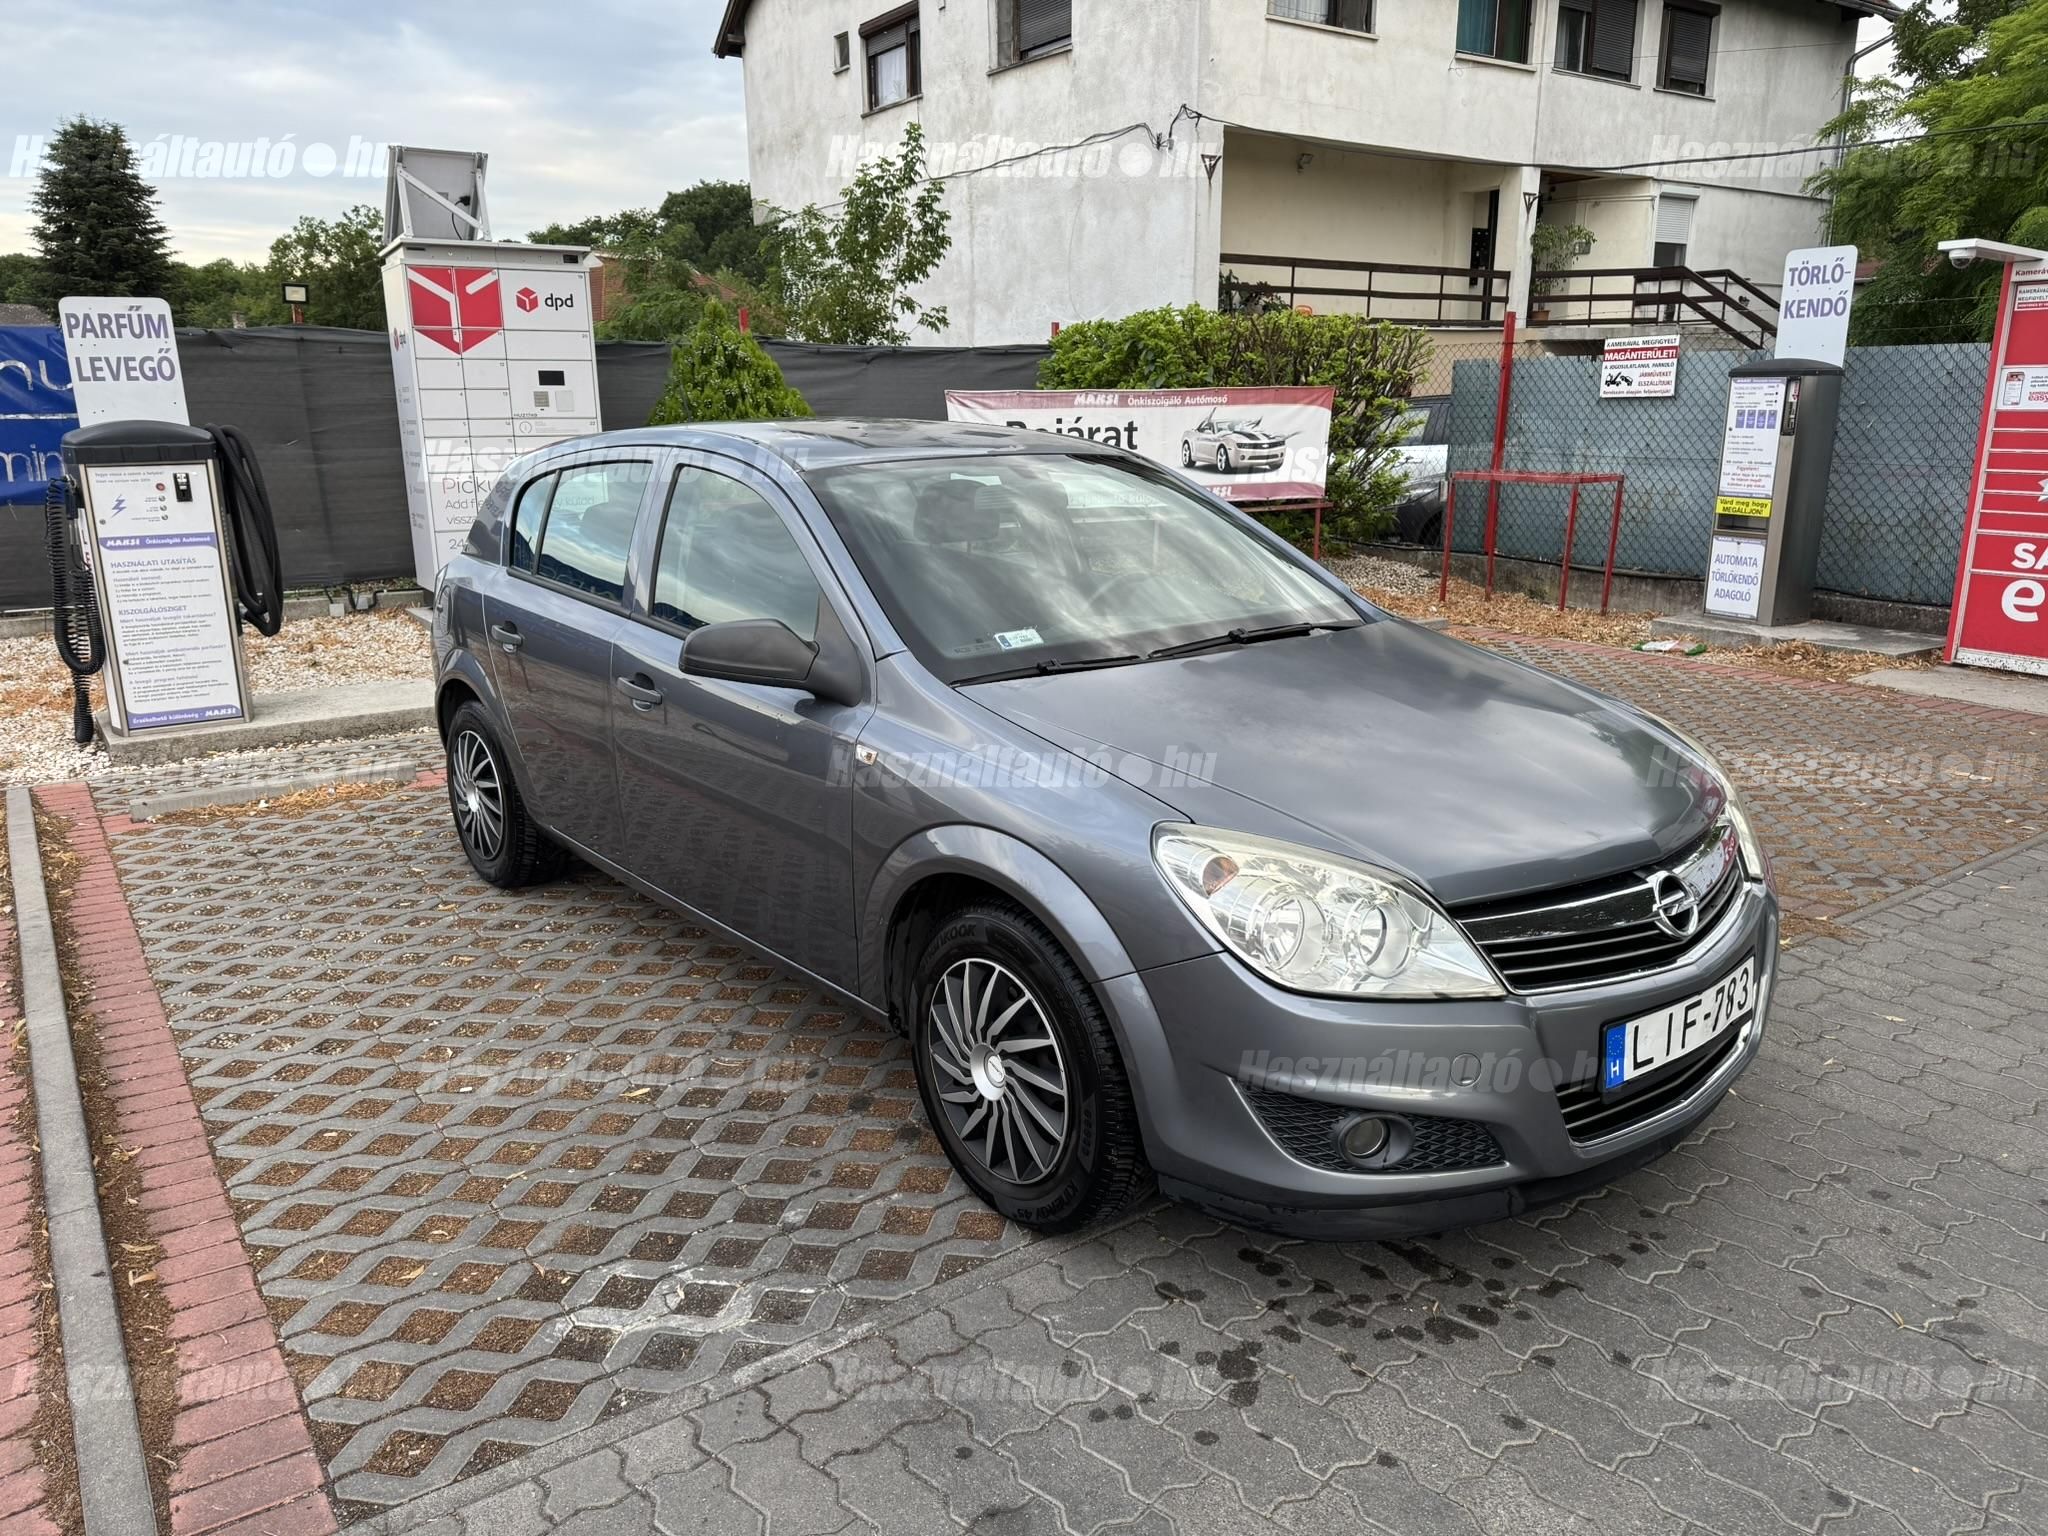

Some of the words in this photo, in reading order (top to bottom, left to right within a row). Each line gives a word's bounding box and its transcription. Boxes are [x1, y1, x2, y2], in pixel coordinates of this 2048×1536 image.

[1789, 257, 1851, 286] TÖRLŐ-
[544, 293, 574, 311] dpd
[1784, 290, 1848, 319] KENDŐ
[1604, 347, 1676, 361] MAGÁNTERÜLET!
[75, 348, 176, 382] LEVEGŐ
[1074, 394, 1119, 406] MAKSI
[1127, 394, 1182, 407] Önkiszolgáló
[446, 498, 469, 509] Add
[1751, 500, 1769, 508] hogy
[106, 538, 140, 547] MAKSI
[110, 559, 160, 569] HASZNÁLATI
[160, 557, 197, 567] UTASÍTÁS
[1714, 553, 1758, 568] AUTOMATA
[1714, 588, 1752, 602] ADAGOLÓ
[118, 604, 188, 616] KISZOLGÁLÓSZIGET
[204, 707, 237, 718] MAKSI
[1633, 967, 1749, 1071] LIF-783
[1610, 1060, 1620, 1079] H
